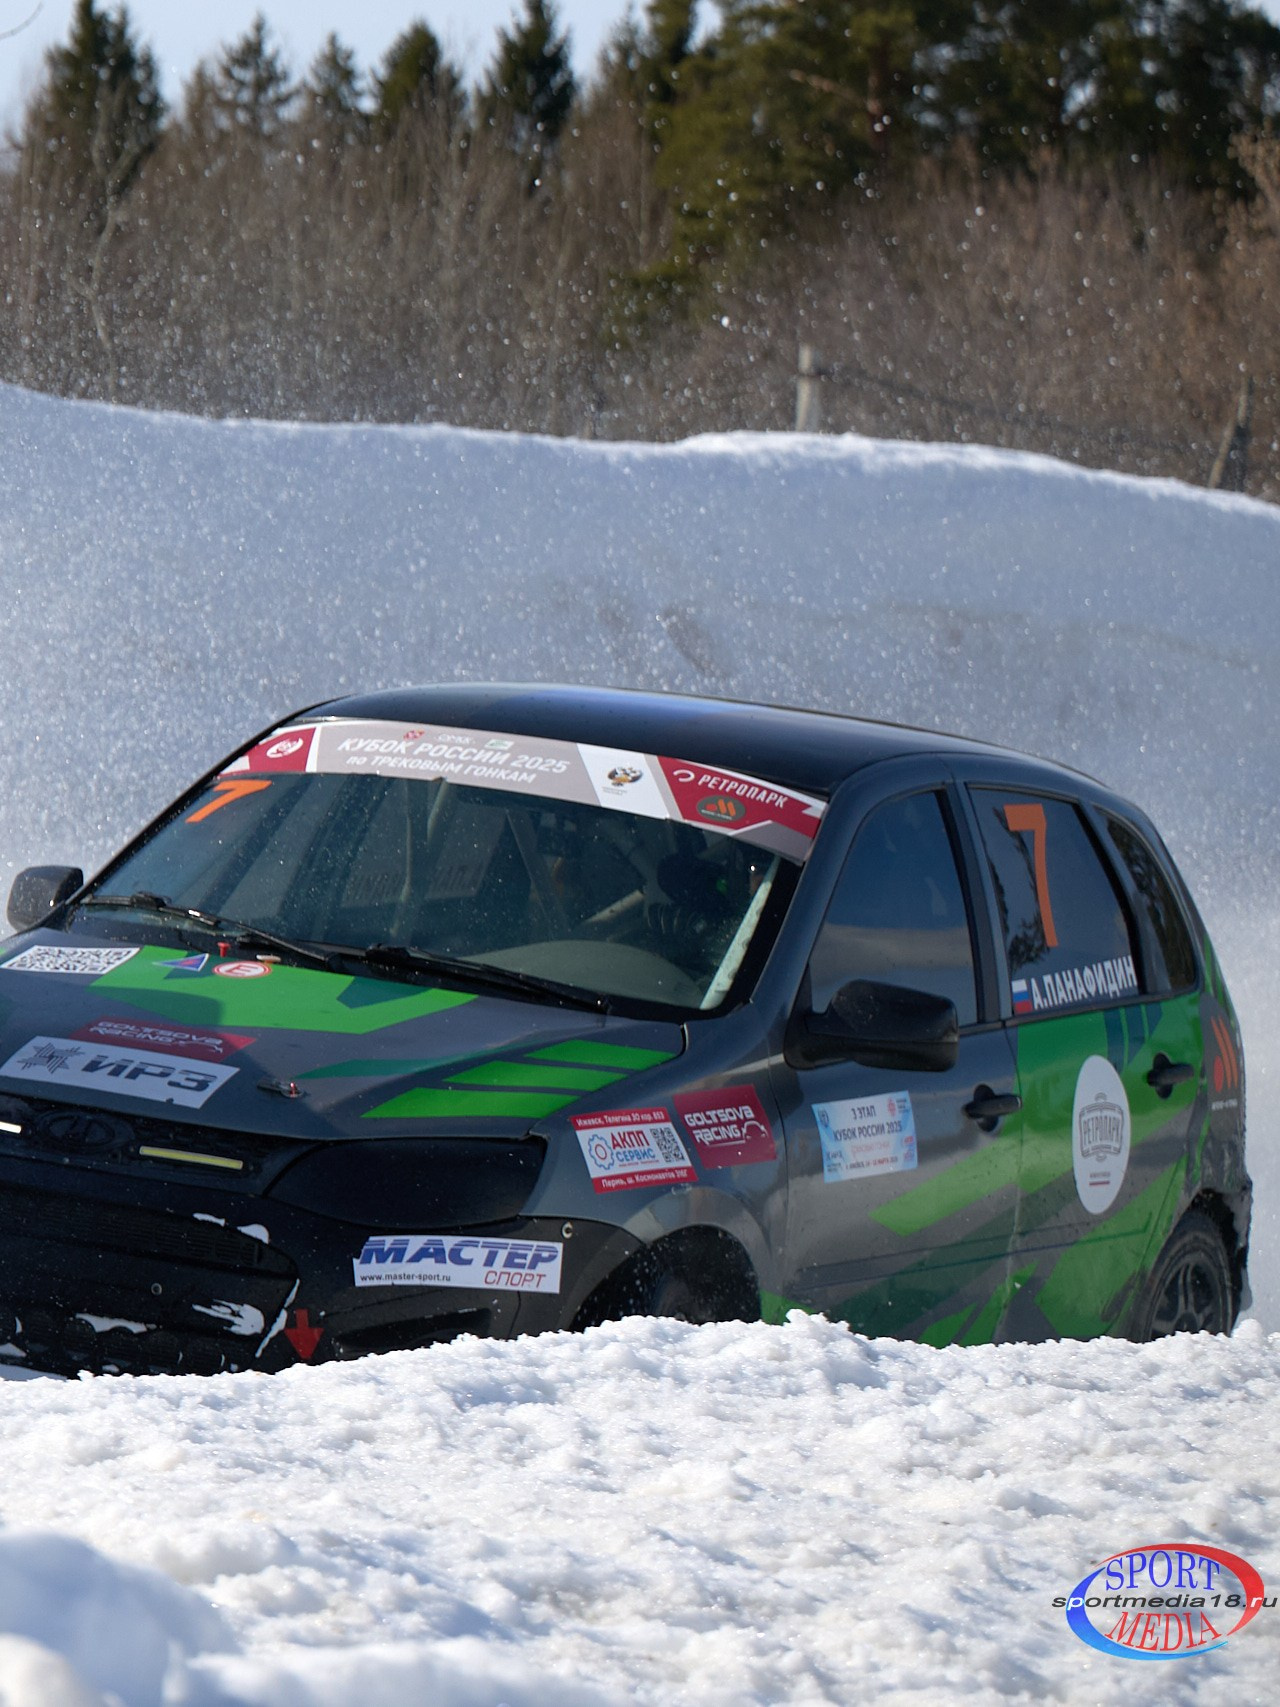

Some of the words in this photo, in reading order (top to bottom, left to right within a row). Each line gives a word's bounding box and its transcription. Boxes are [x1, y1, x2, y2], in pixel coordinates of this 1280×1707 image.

[337, 738, 414, 755] КУБОК
[413, 742, 511, 765] РОССИИ
[510, 754, 571, 774] 2025
[346, 755, 367, 765] по
[371, 756, 463, 773] ТРЕКОВЫМ
[464, 764, 536, 783] ГОНКАМ
[185, 779, 273, 823] 7
[698, 774, 789, 809] РЕТРОПАРК
[1004, 803, 1058, 947] 7
[1030, 955, 1138, 1010] А.ПАНАФИДИН
[82, 1054, 218, 1092] ИРЗ
[684, 1105, 755, 1127] GOLTSOVA
[610, 1130, 650, 1150] АКПП
[692, 1124, 741, 1146] RACING
[833, 1126, 857, 1142] КУБОК
[857, 1123, 885, 1138] РОССИИ
[615, 1148, 656, 1163] СЕРВИС
[359, 1239, 559, 1270] МАСТЕР
[360, 1271, 451, 1282] www.master-sport.ru
[484, 1270, 546, 1288] СПОРТ
